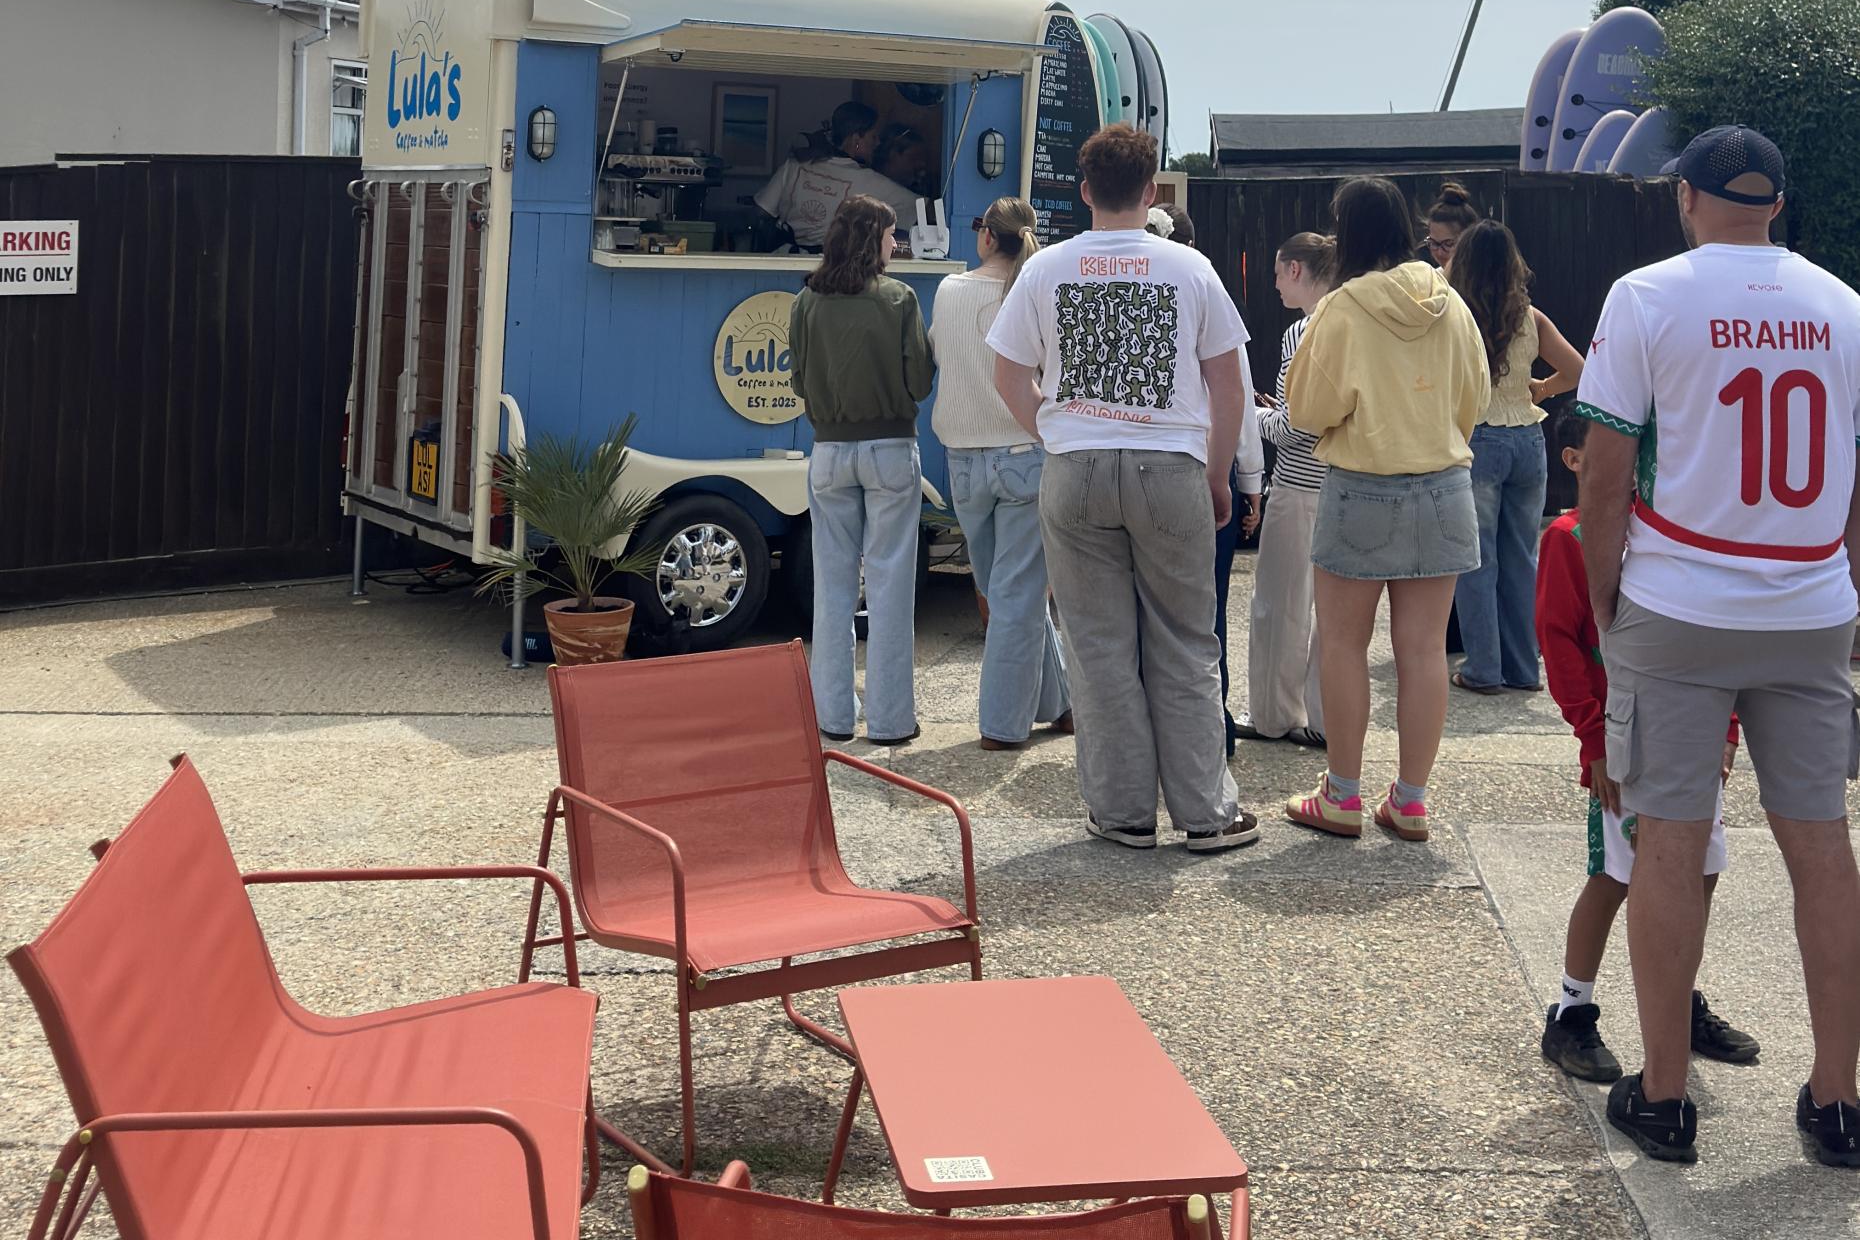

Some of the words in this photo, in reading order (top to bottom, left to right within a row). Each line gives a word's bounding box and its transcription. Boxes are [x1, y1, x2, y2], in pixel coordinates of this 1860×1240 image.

[1047, 37, 1071, 52] COFFEE
[1042, 73, 1056, 82] LATTE
[1043, 66, 1055, 74] FLAT
[1054, 68, 1066, 76] WHITE
[388, 49, 462, 129] Lula's
[1040, 88, 1056, 97] MOCHA
[1041, 81, 1068, 91] CAPPUCCINO
[1040, 97, 1054, 106] DIRTY
[1039, 117, 1052, 130] NOT
[1053, 120, 1072, 132] COFFEE
[396, 131, 417, 152] Coffee
[424, 125, 449, 150] matcha
[1034, 170, 1055, 180] CAMPFIRE
[1032, 198, 1042, 208] FUN
[0, 231, 71, 251] RKING
[33, 266, 74, 282] ONLY
[1080, 257, 1150, 276] KEITH
[1710, 319, 1831, 351] BRAHIM
[723, 334, 793, 377] Lula
[738, 378, 767, 389] Coffee
[777, 378, 793, 389] mat
[748, 396, 769, 409] EST.
[771, 396, 797, 408] 2025
[1718, 366, 1827, 508] 10
